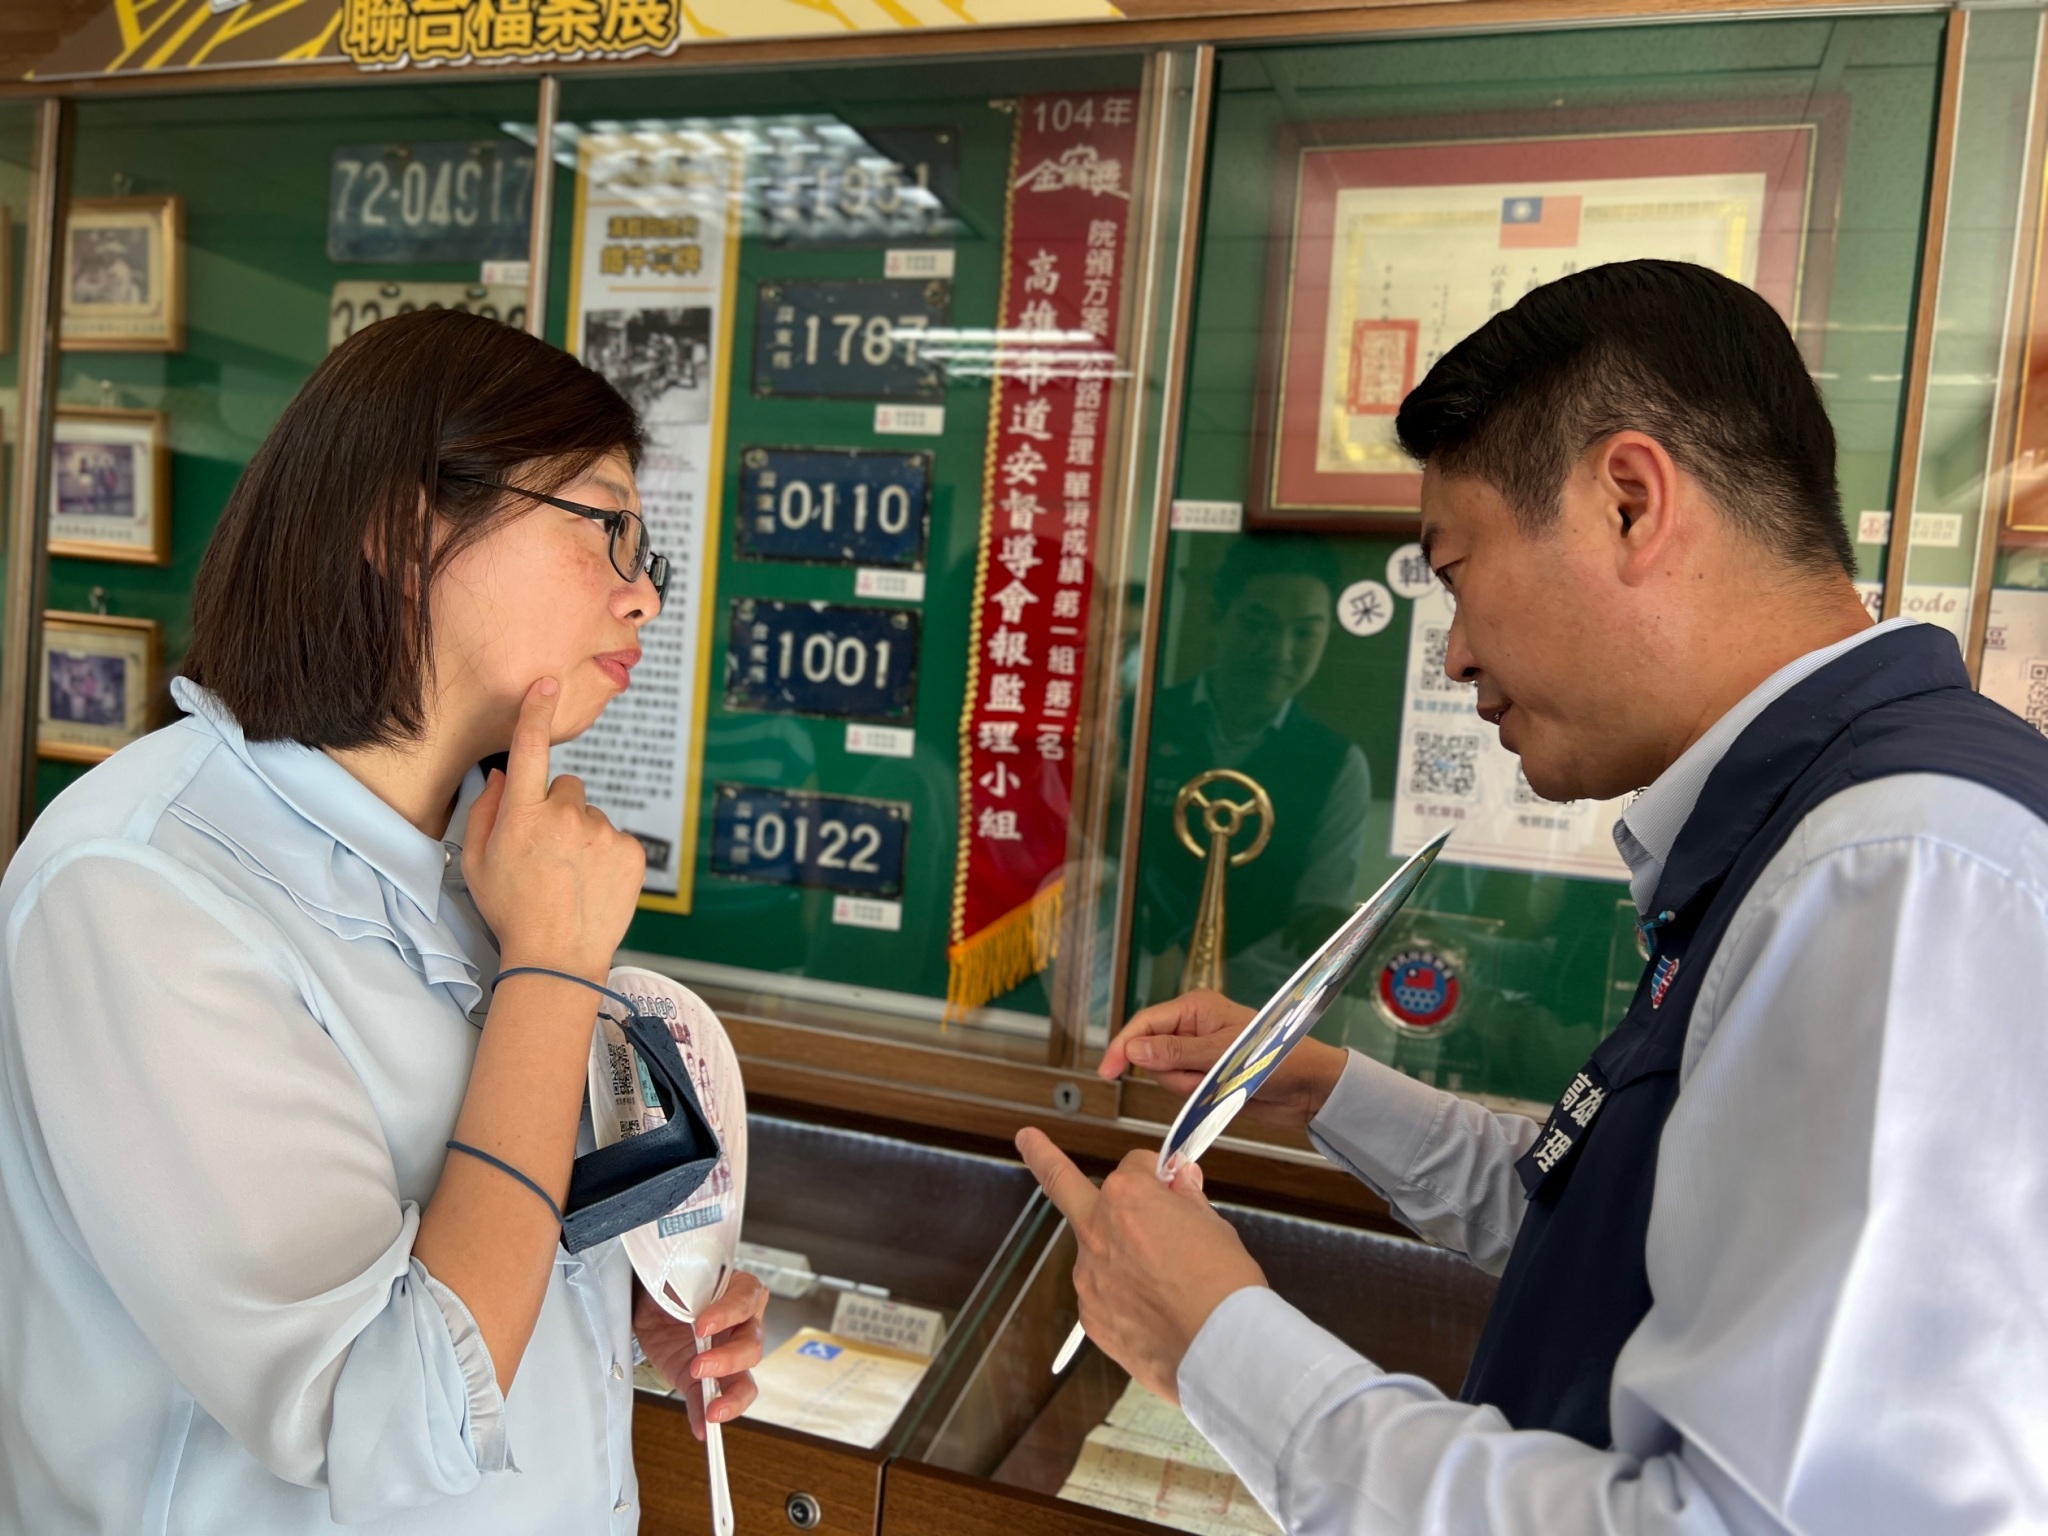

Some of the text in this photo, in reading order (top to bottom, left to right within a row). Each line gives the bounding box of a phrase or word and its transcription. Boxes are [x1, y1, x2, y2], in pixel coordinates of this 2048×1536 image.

[805, 314, 929, 367] 1787
[779, 480, 911, 535] 0110
[779, 630, 891, 690] 1001
[754, 812, 882, 874] 0122
[1533, 1118, 1573, 1173] 理
